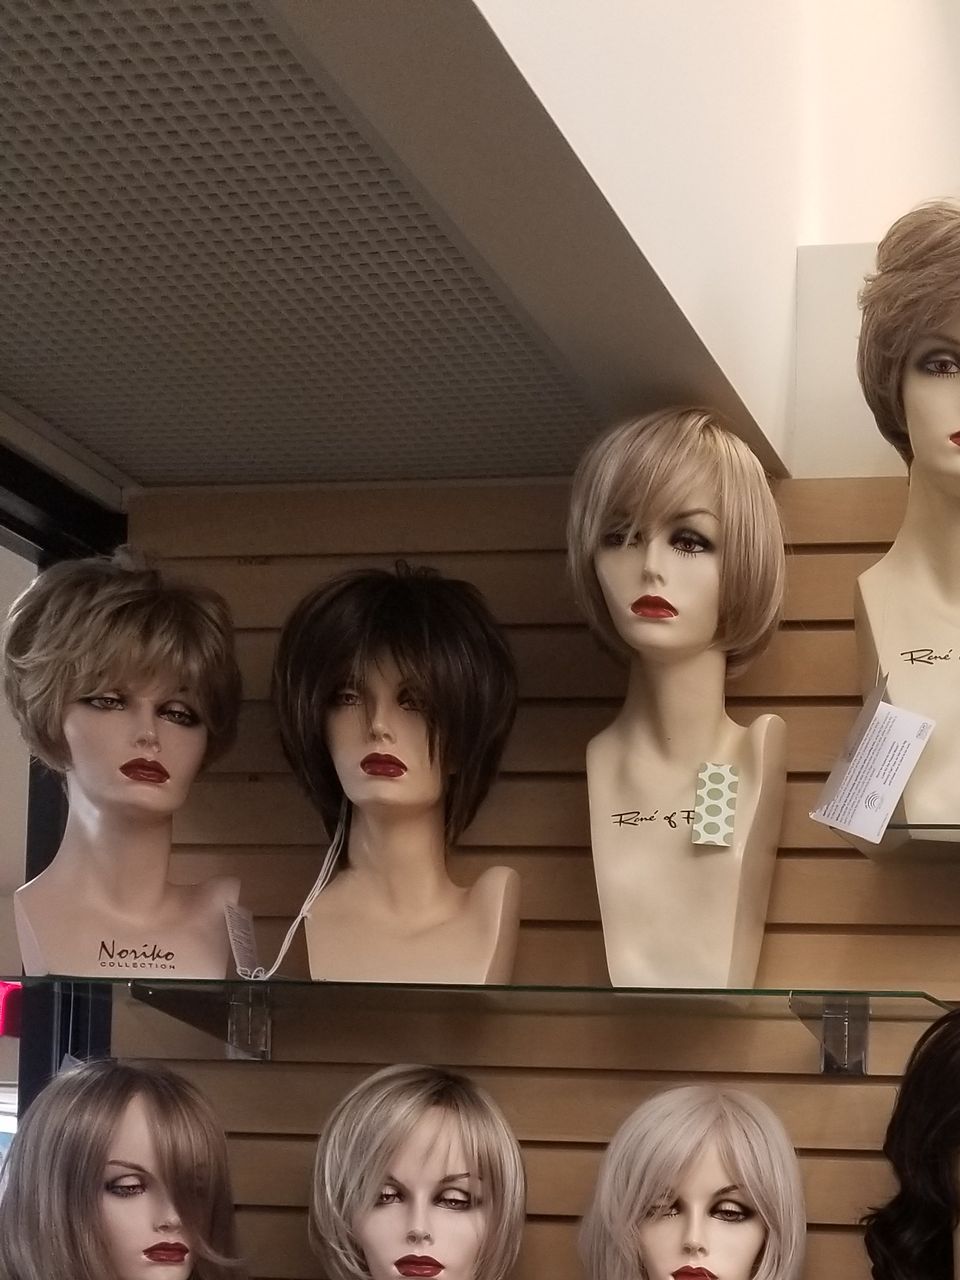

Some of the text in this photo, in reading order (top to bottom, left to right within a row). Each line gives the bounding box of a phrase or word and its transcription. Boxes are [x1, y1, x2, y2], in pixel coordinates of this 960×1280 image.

[663, 811, 677, 829] of
[98, 939, 175, 961] Noriko
[99, 961, 176, 970] COLLECTION
